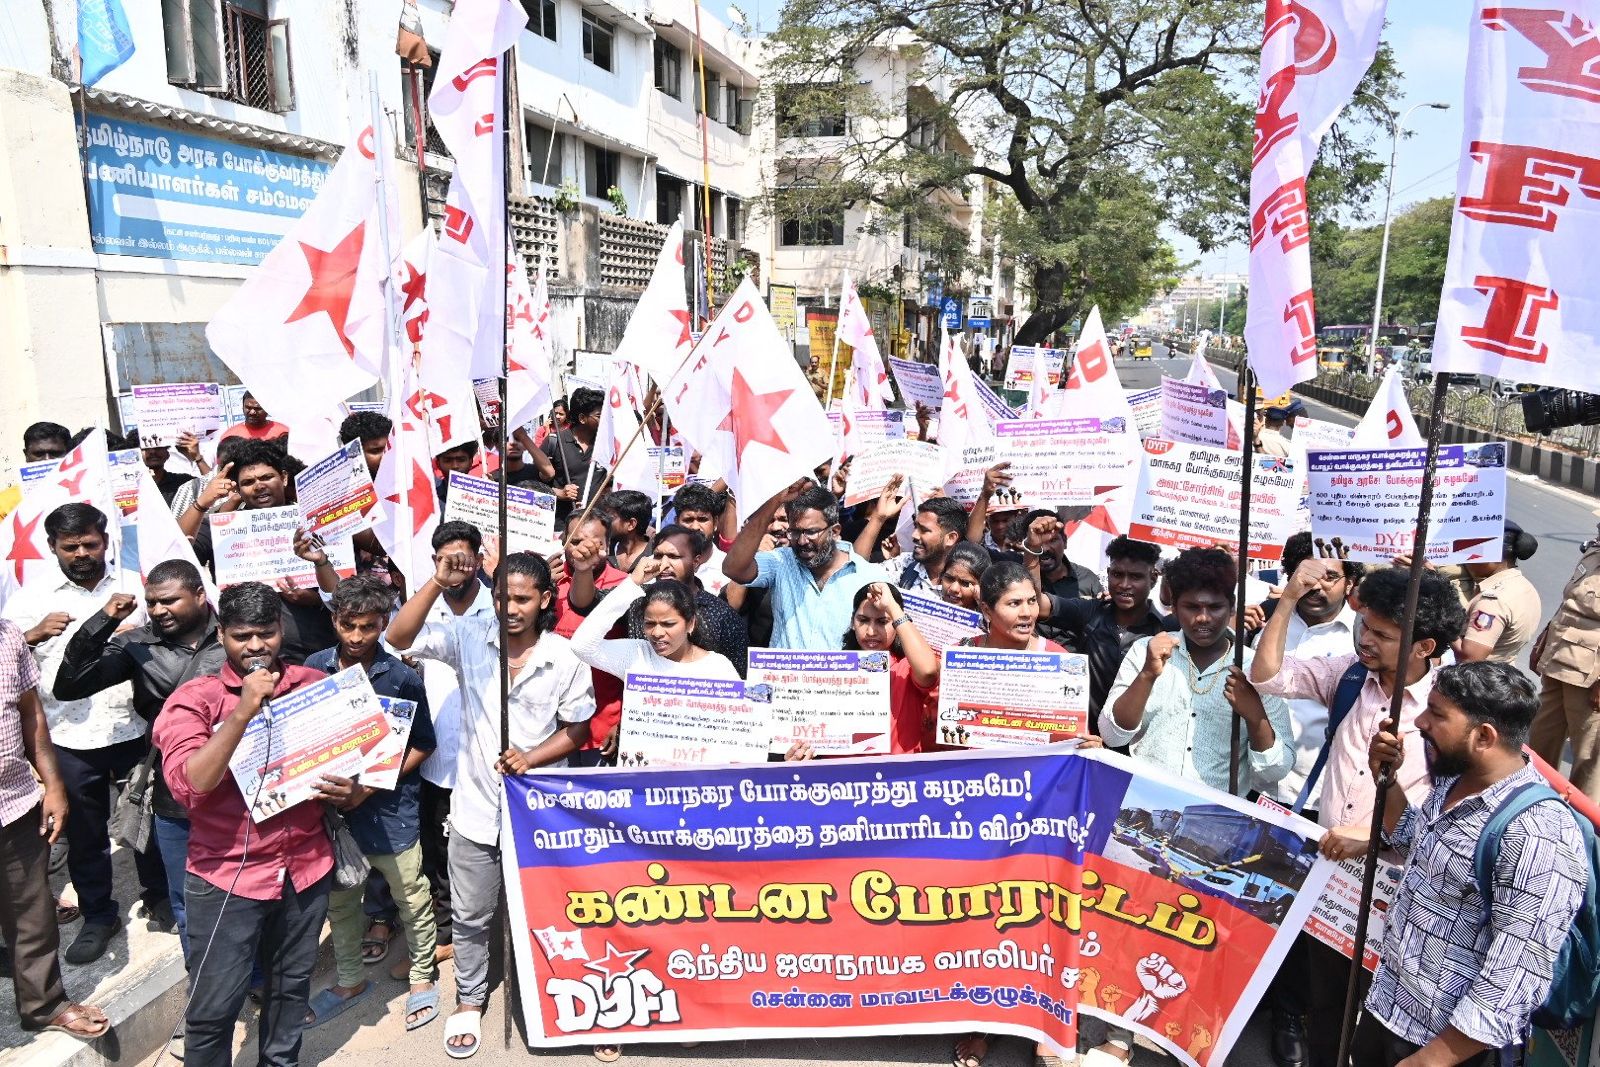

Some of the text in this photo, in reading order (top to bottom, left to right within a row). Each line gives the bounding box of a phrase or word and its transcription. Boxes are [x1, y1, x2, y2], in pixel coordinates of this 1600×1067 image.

[177, 144, 218, 170] அரசு
[675, 300, 754, 404] DYFI
[1147, 440, 1169, 452] DYFI
[1189, 450, 1221, 464] தமிழக
[1150, 457, 1182, 472] மாநகர
[1331, 474, 1354, 488] தமிழக
[1356, 475, 1381, 487] அரசே!
[793, 722, 827, 738] DYFI
[981, 716, 1078, 733] கண்டன போராட்டம்
[526, 770, 1033, 812] சென்னை மாநகர போக்குவரத்து கழகமே!
[533, 821, 625, 855] பொதுப்
[628, 817, 814, 853] போக்குவரத்தை
[819, 815, 973, 849] தனியாரிடம்
[565, 863, 834, 927] கண்டன
[665, 937, 1055, 980] இந்திய ஜனநாயக வாலிபர்
[750, 983, 1074, 1027] சென்னை மாவட்டக்குழுக்கள்
